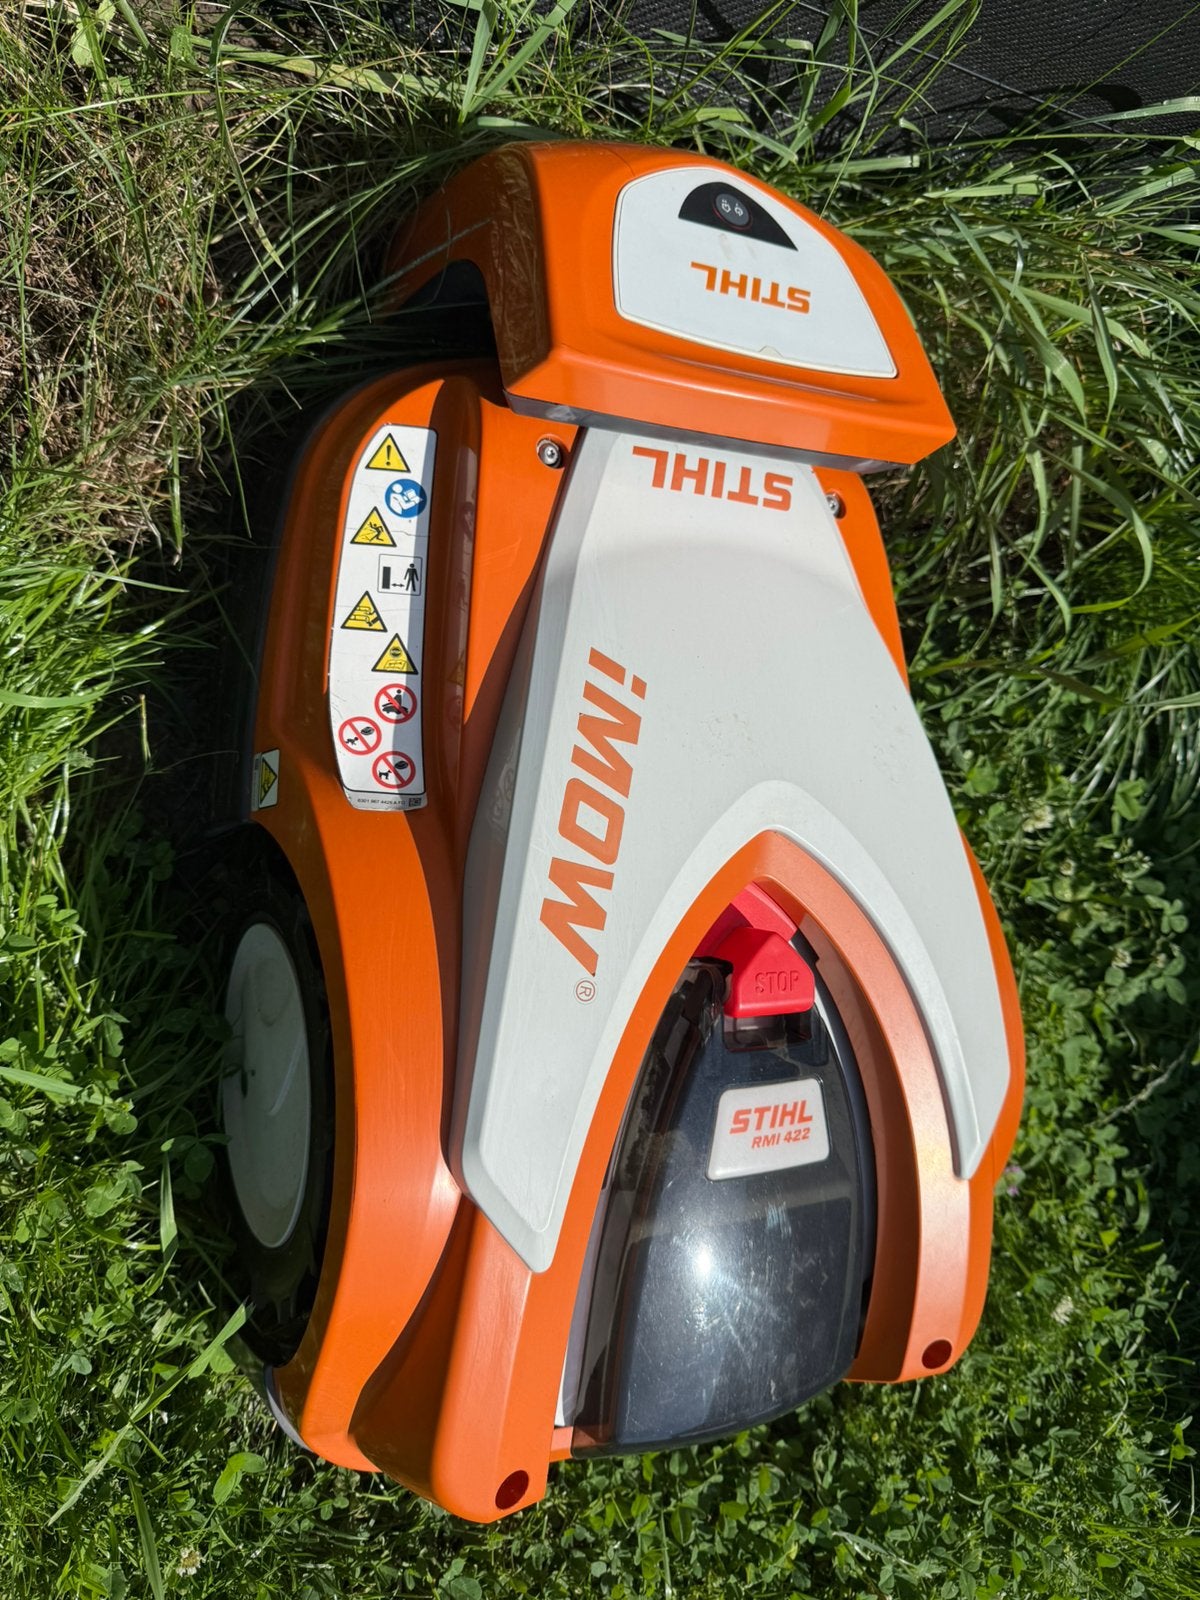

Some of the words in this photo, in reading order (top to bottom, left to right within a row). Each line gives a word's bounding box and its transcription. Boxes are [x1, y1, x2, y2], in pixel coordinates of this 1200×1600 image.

[690, 261, 811, 315] STIHL
[632, 445, 794, 512] STIHL
[754, 970, 799, 993] STOP
[729, 1100, 813, 1134] STIHL
[751, 1132, 781, 1149] RMI
[783, 1127, 811, 1144] 422
